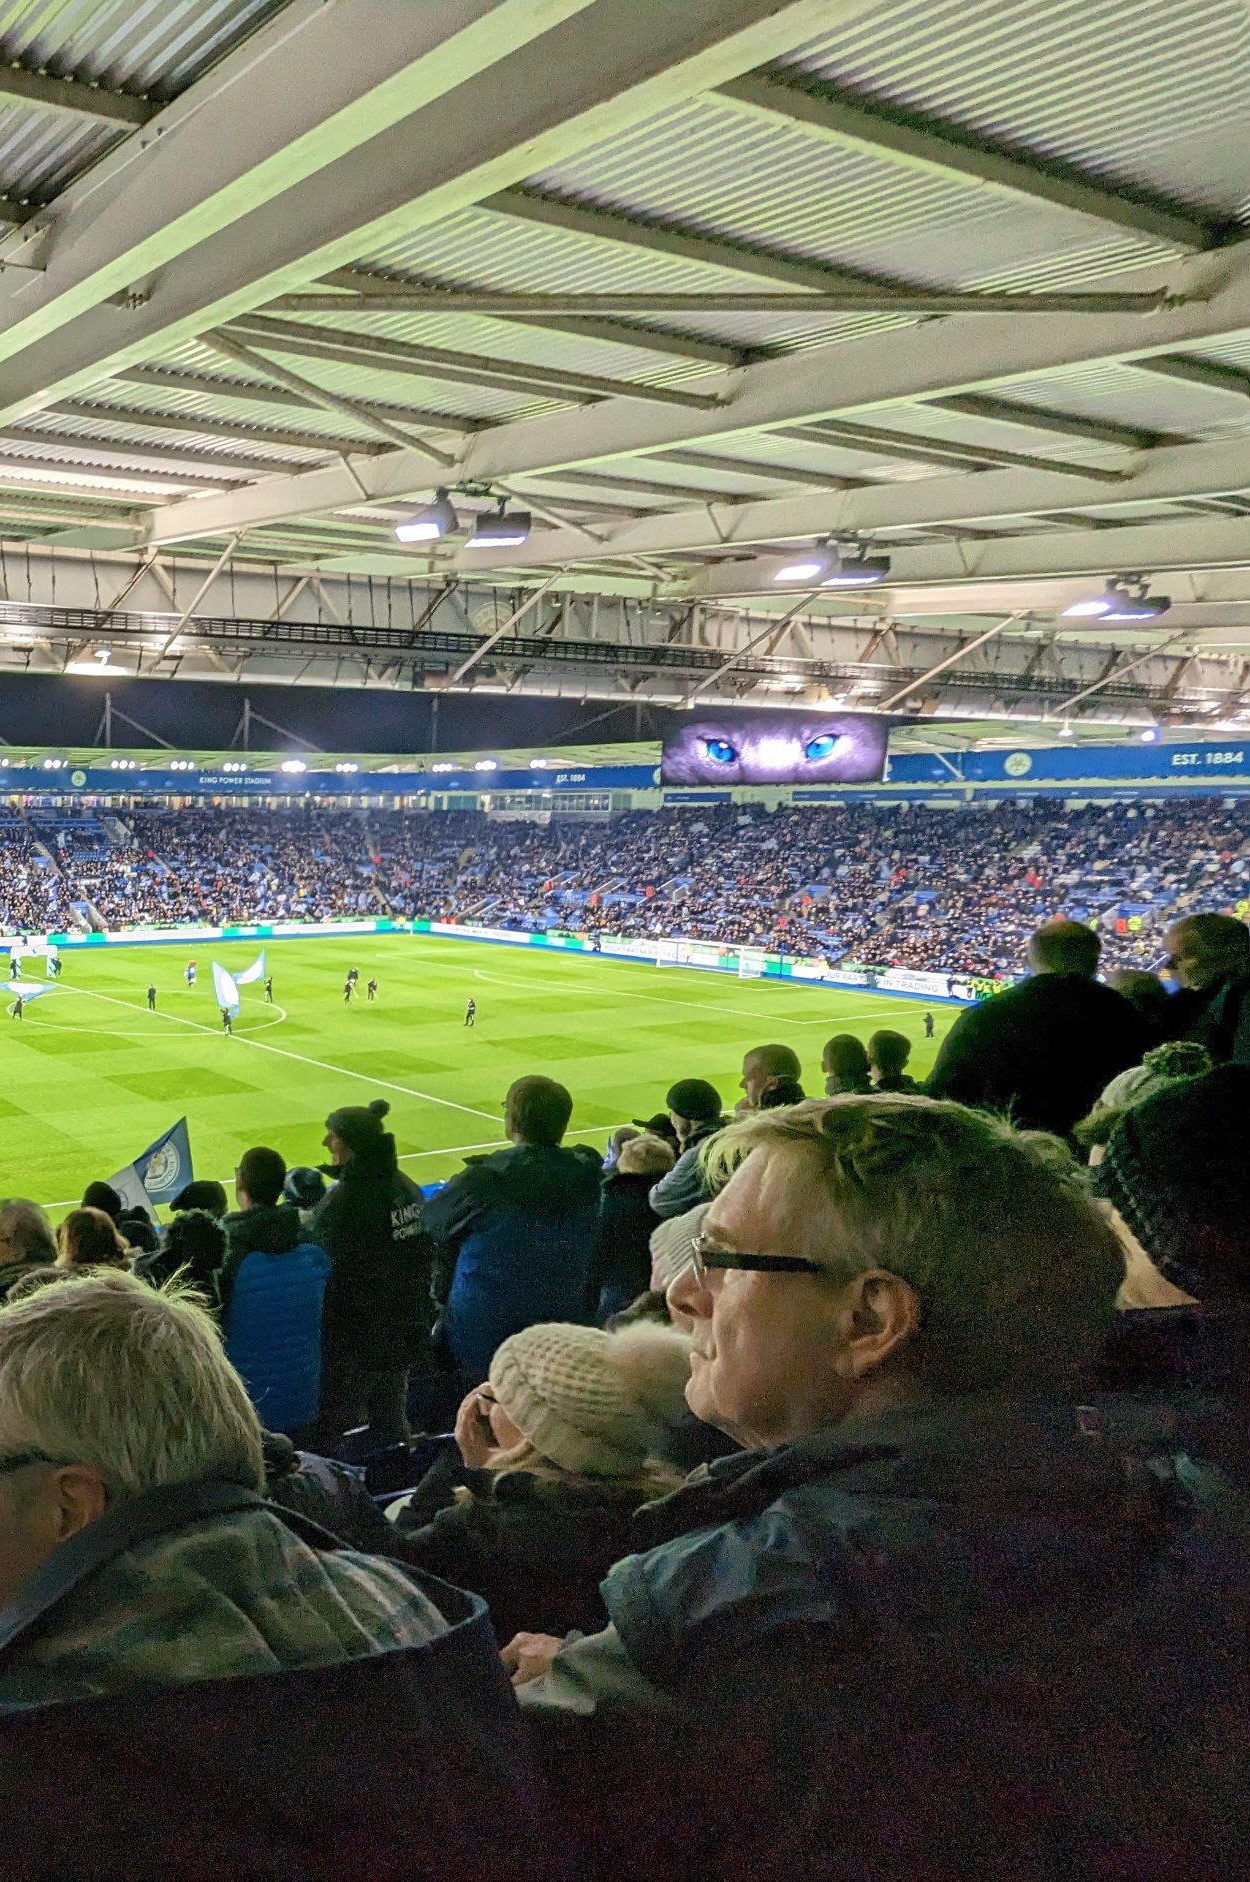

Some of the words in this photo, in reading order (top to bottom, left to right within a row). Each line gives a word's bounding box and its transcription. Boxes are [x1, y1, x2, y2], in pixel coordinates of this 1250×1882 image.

[1172, 753, 1202, 766] EST.
[1205, 751, 1244, 765] 1884
[883, 979, 893, 987] IN
[896, 980, 939, 993] TRADING
